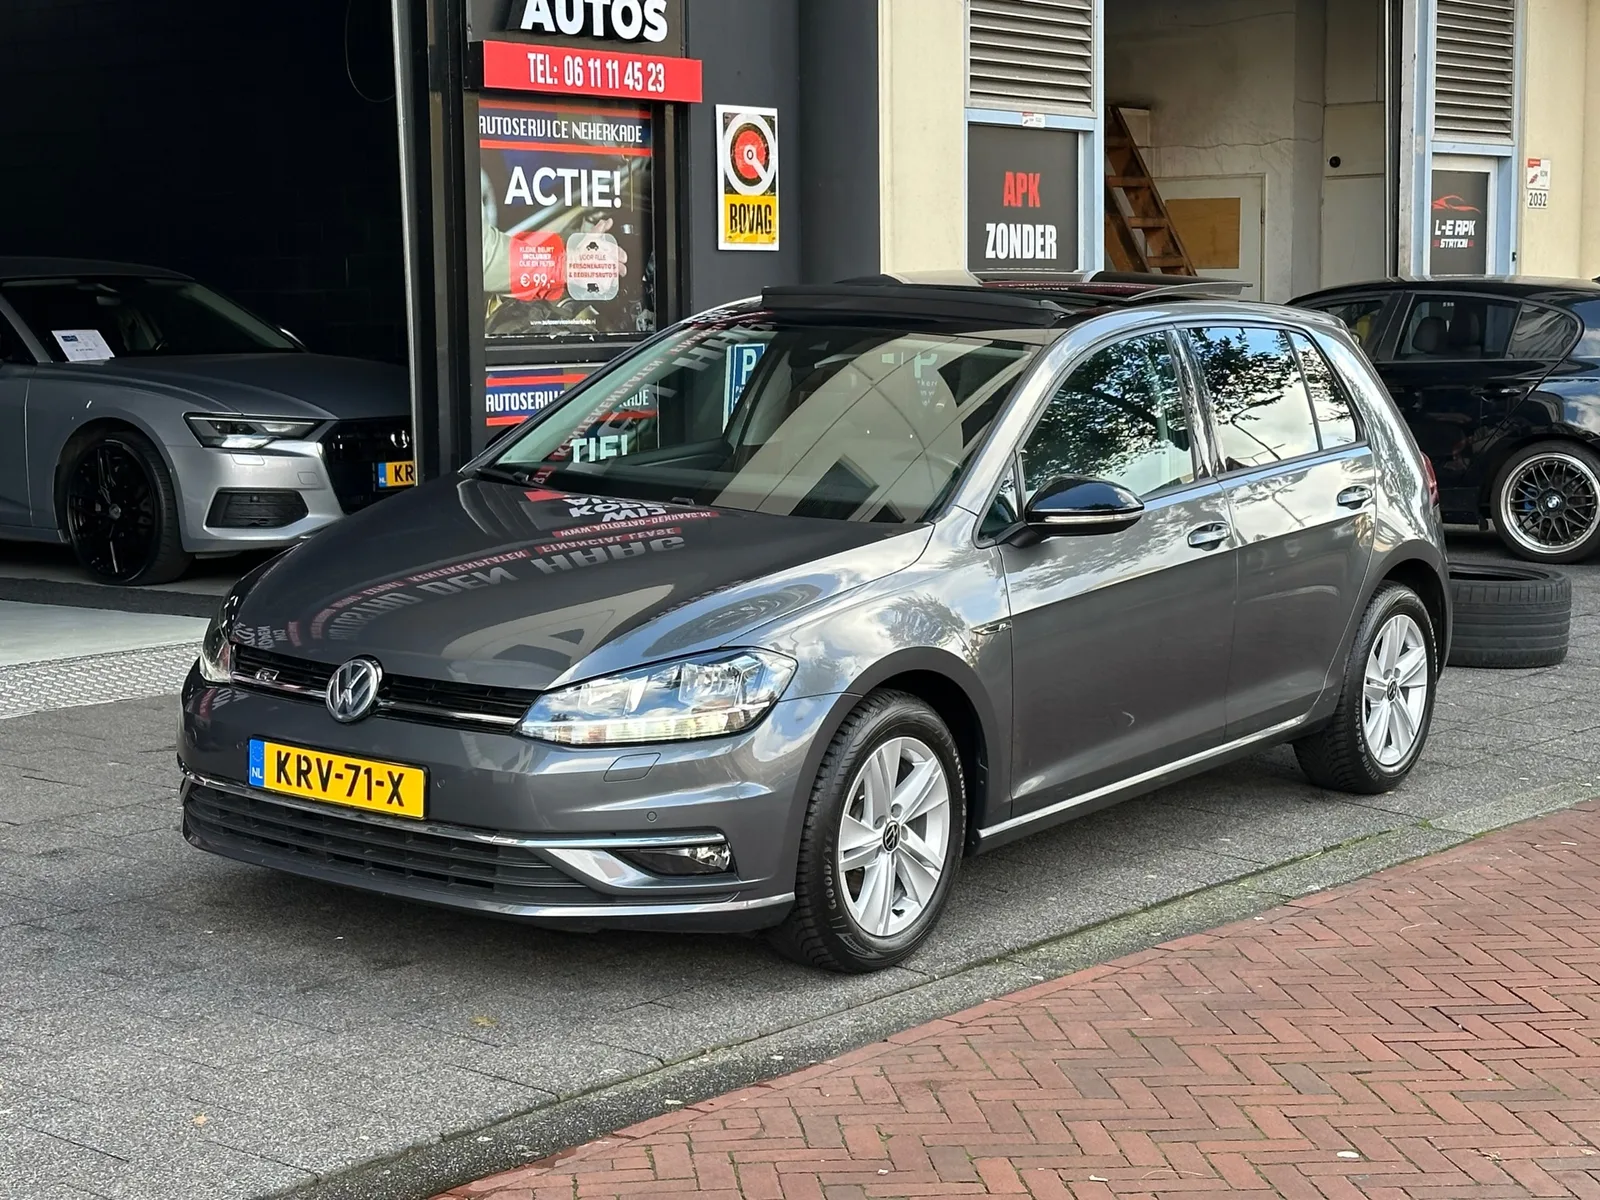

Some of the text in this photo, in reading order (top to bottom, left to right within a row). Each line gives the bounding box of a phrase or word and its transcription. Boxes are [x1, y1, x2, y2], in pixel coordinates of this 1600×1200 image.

[527, 52, 665, 93] TEL: 06 11 11 45 23
[479, 115, 642, 143] AUTOSERVICE NEHERKADE
[504, 166, 622, 209] ACTIE!
[1003, 171, 1041, 208] APK
[1529, 192, 1547, 207] 2032
[729, 203, 772, 234] BOVAG
[1454, 220, 1476, 236] APK
[985, 222, 1057, 260] ZONDER
[1440, 238, 1469, 249] STATION
[520, 273, 531, 287] €
[251, 765, 263, 780] NL
[275, 749, 405, 808] KRV-71-X
